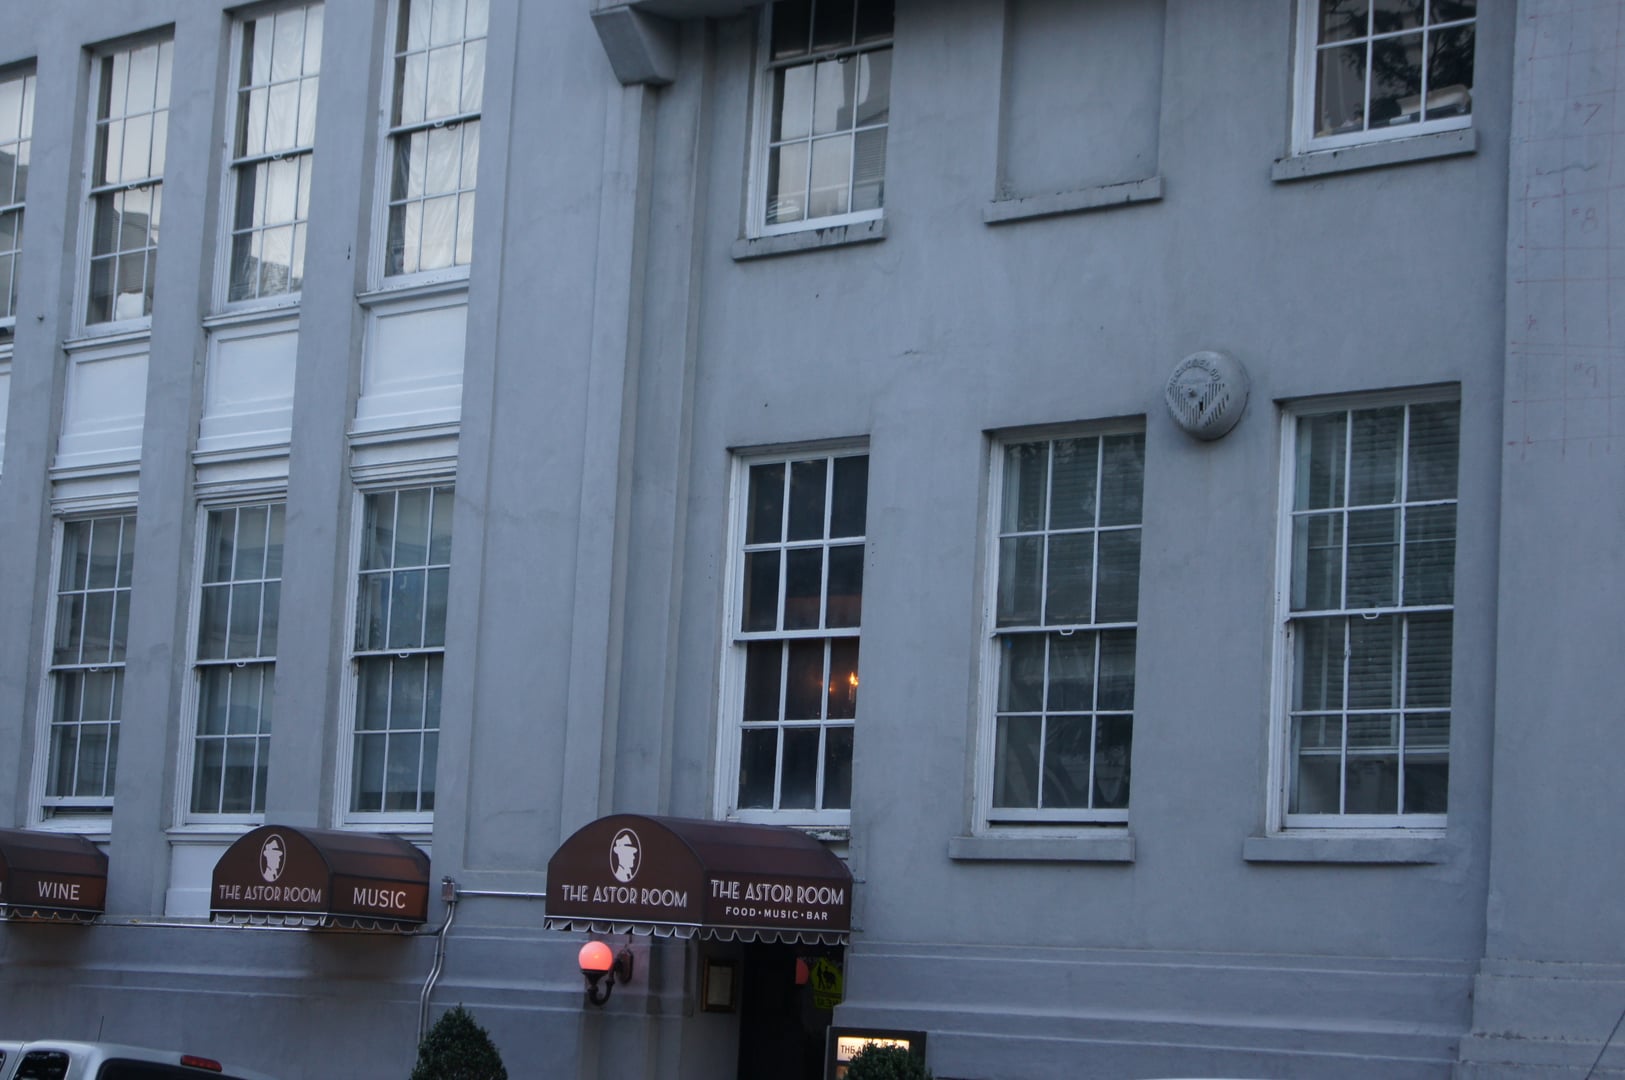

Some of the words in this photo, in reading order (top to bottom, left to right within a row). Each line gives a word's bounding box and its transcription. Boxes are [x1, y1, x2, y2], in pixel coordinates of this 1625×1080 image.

[38, 880, 81, 901] WINE
[219, 884, 241, 900] THE
[244, 885, 281, 902] ASTOR
[283, 887, 321, 903] ROOM
[353, 887, 406, 909] MUSIC
[562, 884, 588, 902] THE
[592, 885, 638, 904] ASTOR
[641, 888, 688, 908] ROOM
[711, 879, 740, 899] THE
[745, 882, 793, 903] ASTOR
[797, 885, 844, 905] ROOM
[725, 906, 756, 917] FOOD
[763, 908, 799, 920] MUSIC
[806, 911, 828, 921] BAR
